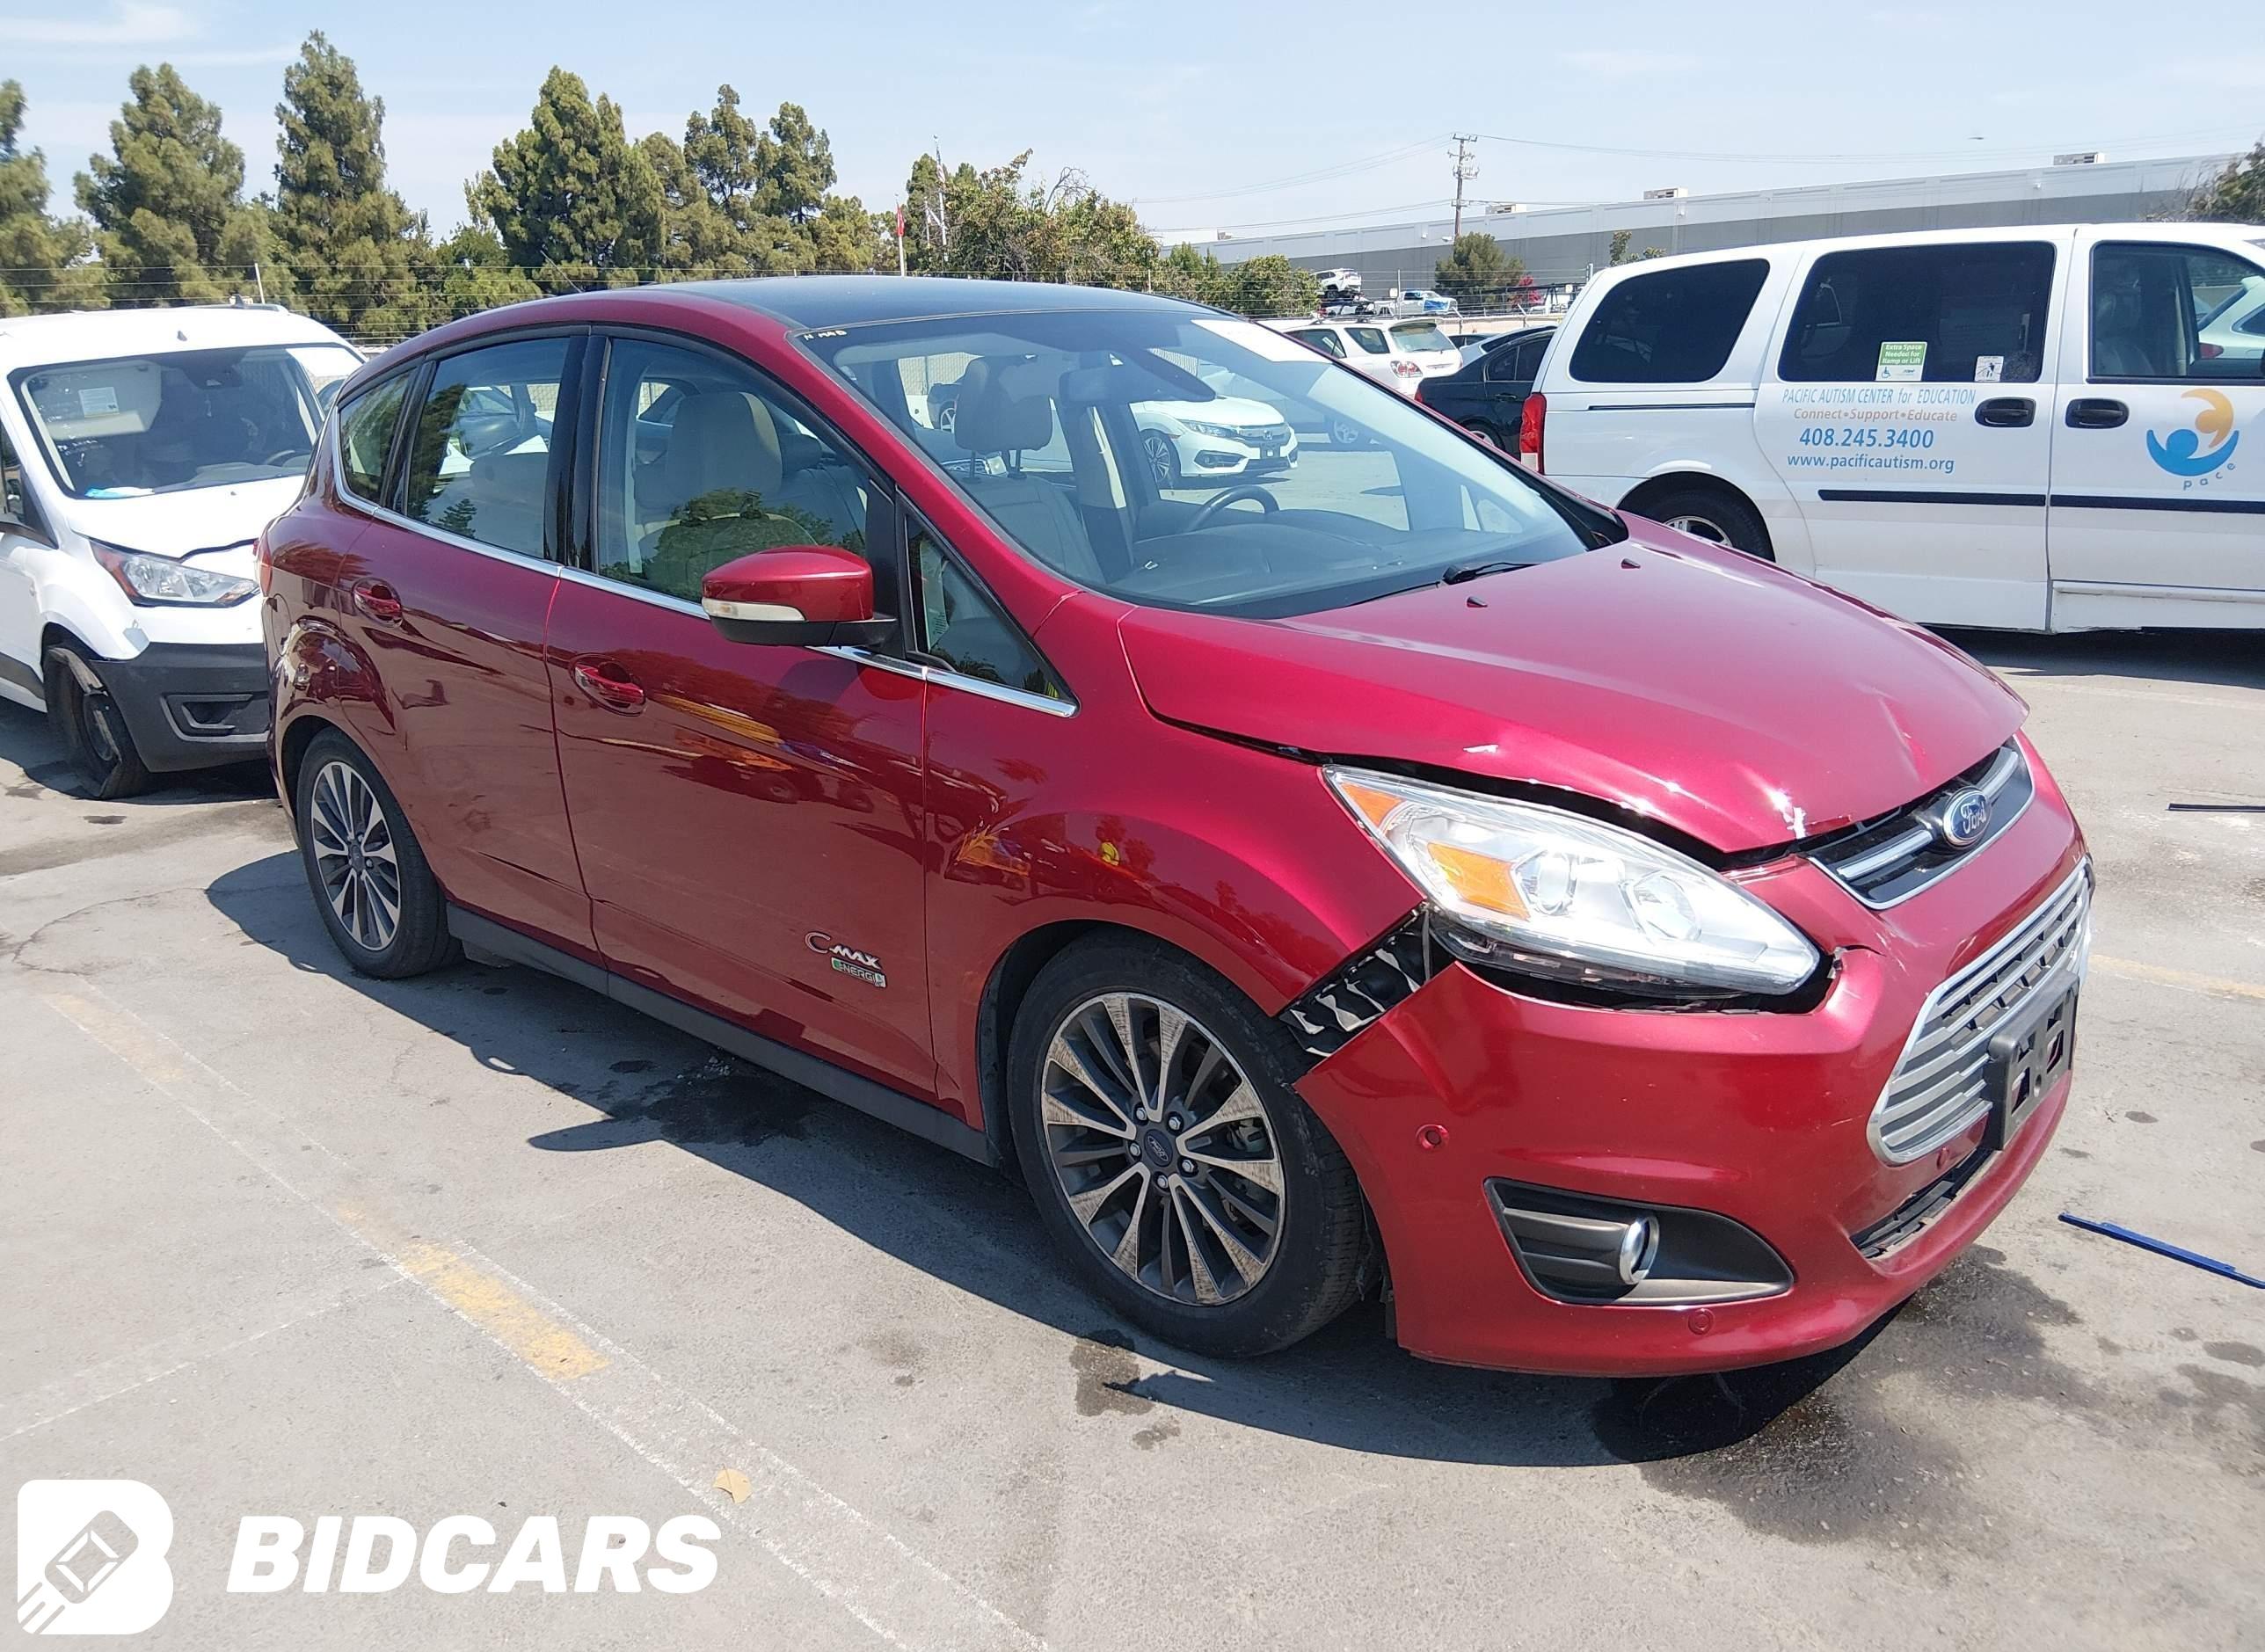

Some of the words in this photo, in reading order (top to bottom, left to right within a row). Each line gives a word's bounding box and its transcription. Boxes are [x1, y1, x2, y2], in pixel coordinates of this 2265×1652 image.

[1782, 389, 1817, 403] PACIFIC
[1819, 389, 1856, 403] AUTISM
[1857, 389, 1894, 404] CENTER
[1897, 389, 1913, 403] for
[1916, 389, 1977, 404] EDUCATION
[1799, 427, 1934, 448] 408.245.3400
[1787, 454, 1955, 474] www.pacificautism.org
[1961, 799, 1986, 834] Ford
